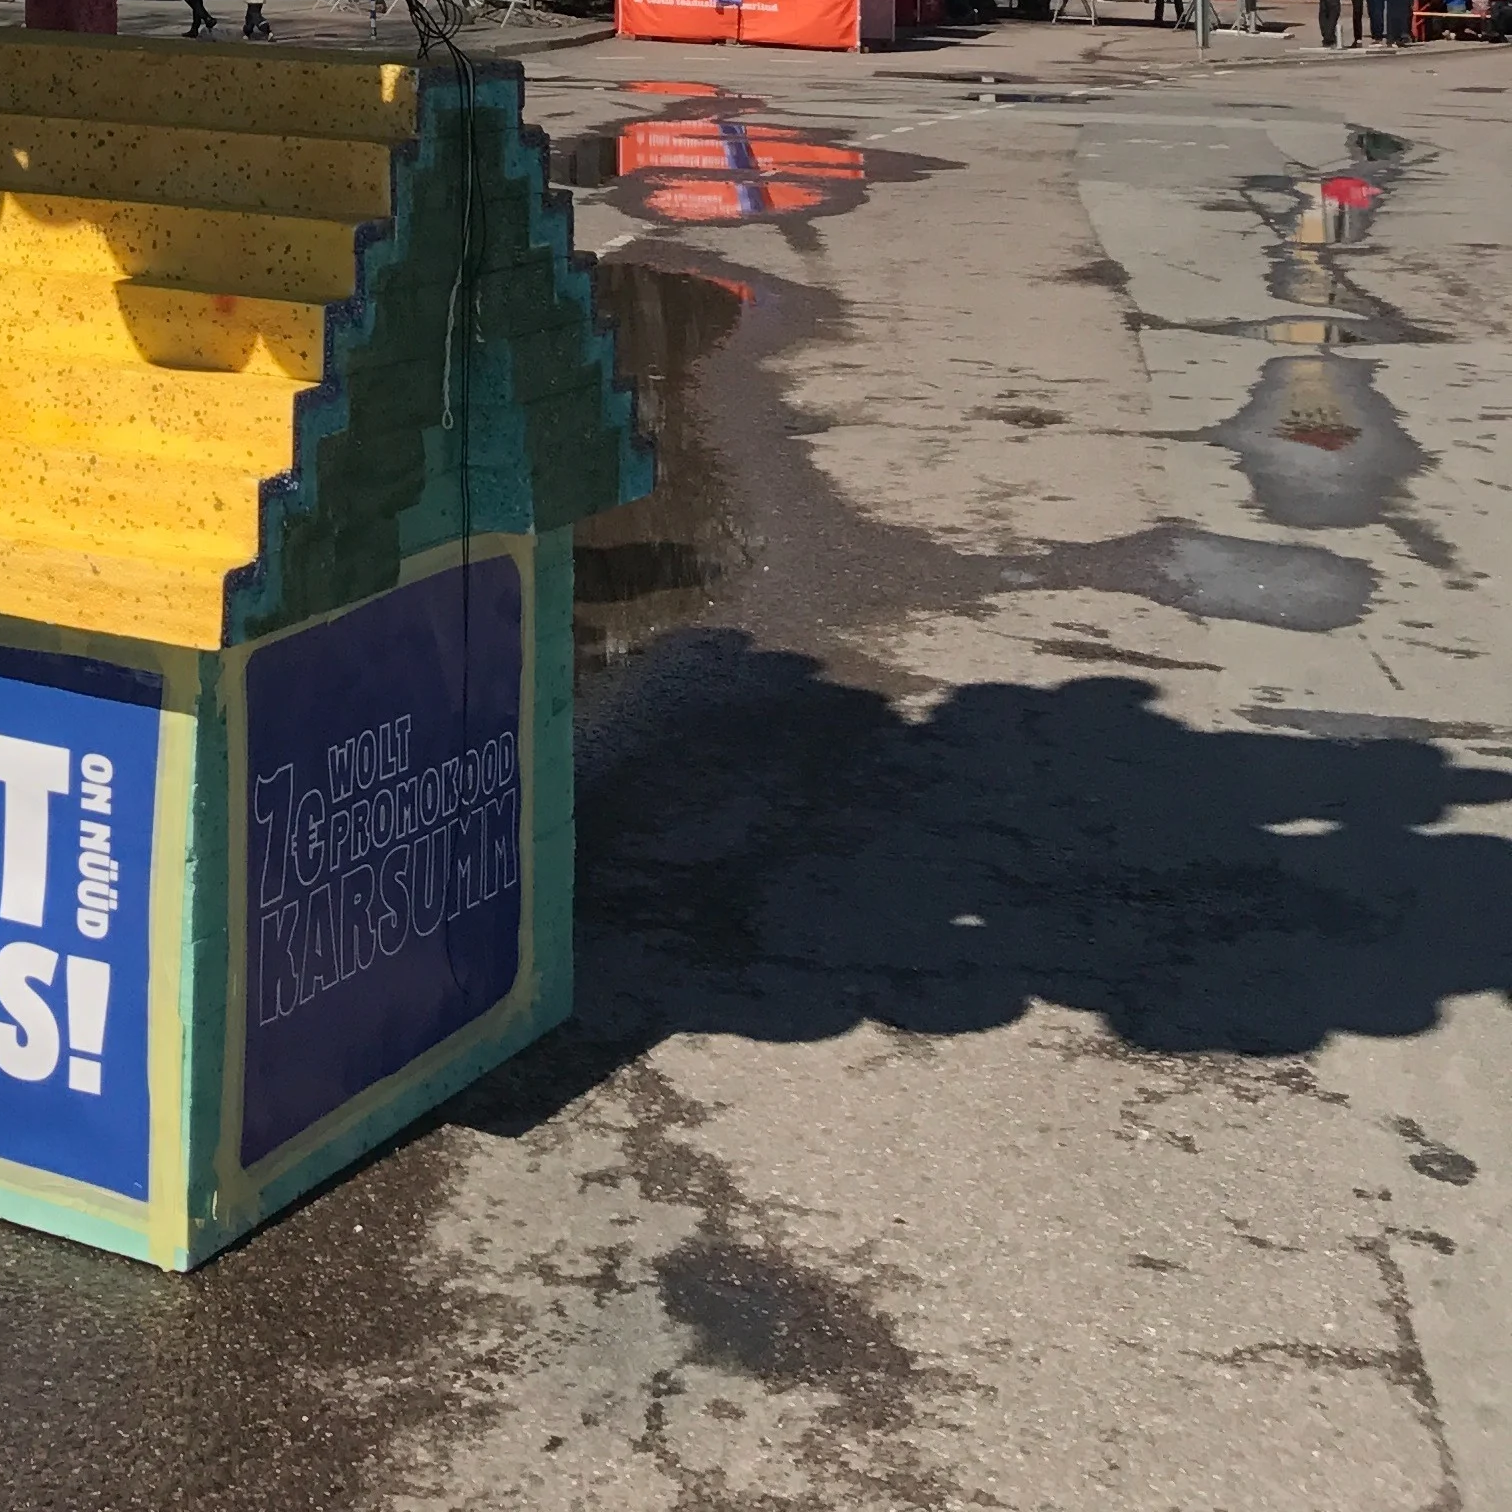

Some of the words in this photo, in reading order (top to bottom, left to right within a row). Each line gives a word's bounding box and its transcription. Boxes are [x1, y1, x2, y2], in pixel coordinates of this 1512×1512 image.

[80, 752, 113, 816] ON
[327, 713, 412, 804] WOLT
[76, 819, 115, 940] NÜÜD
[254, 763, 326, 909] 7€
[329, 731, 515, 872] PROMOKOOD
[259, 787, 518, 1028] KARSUMM
